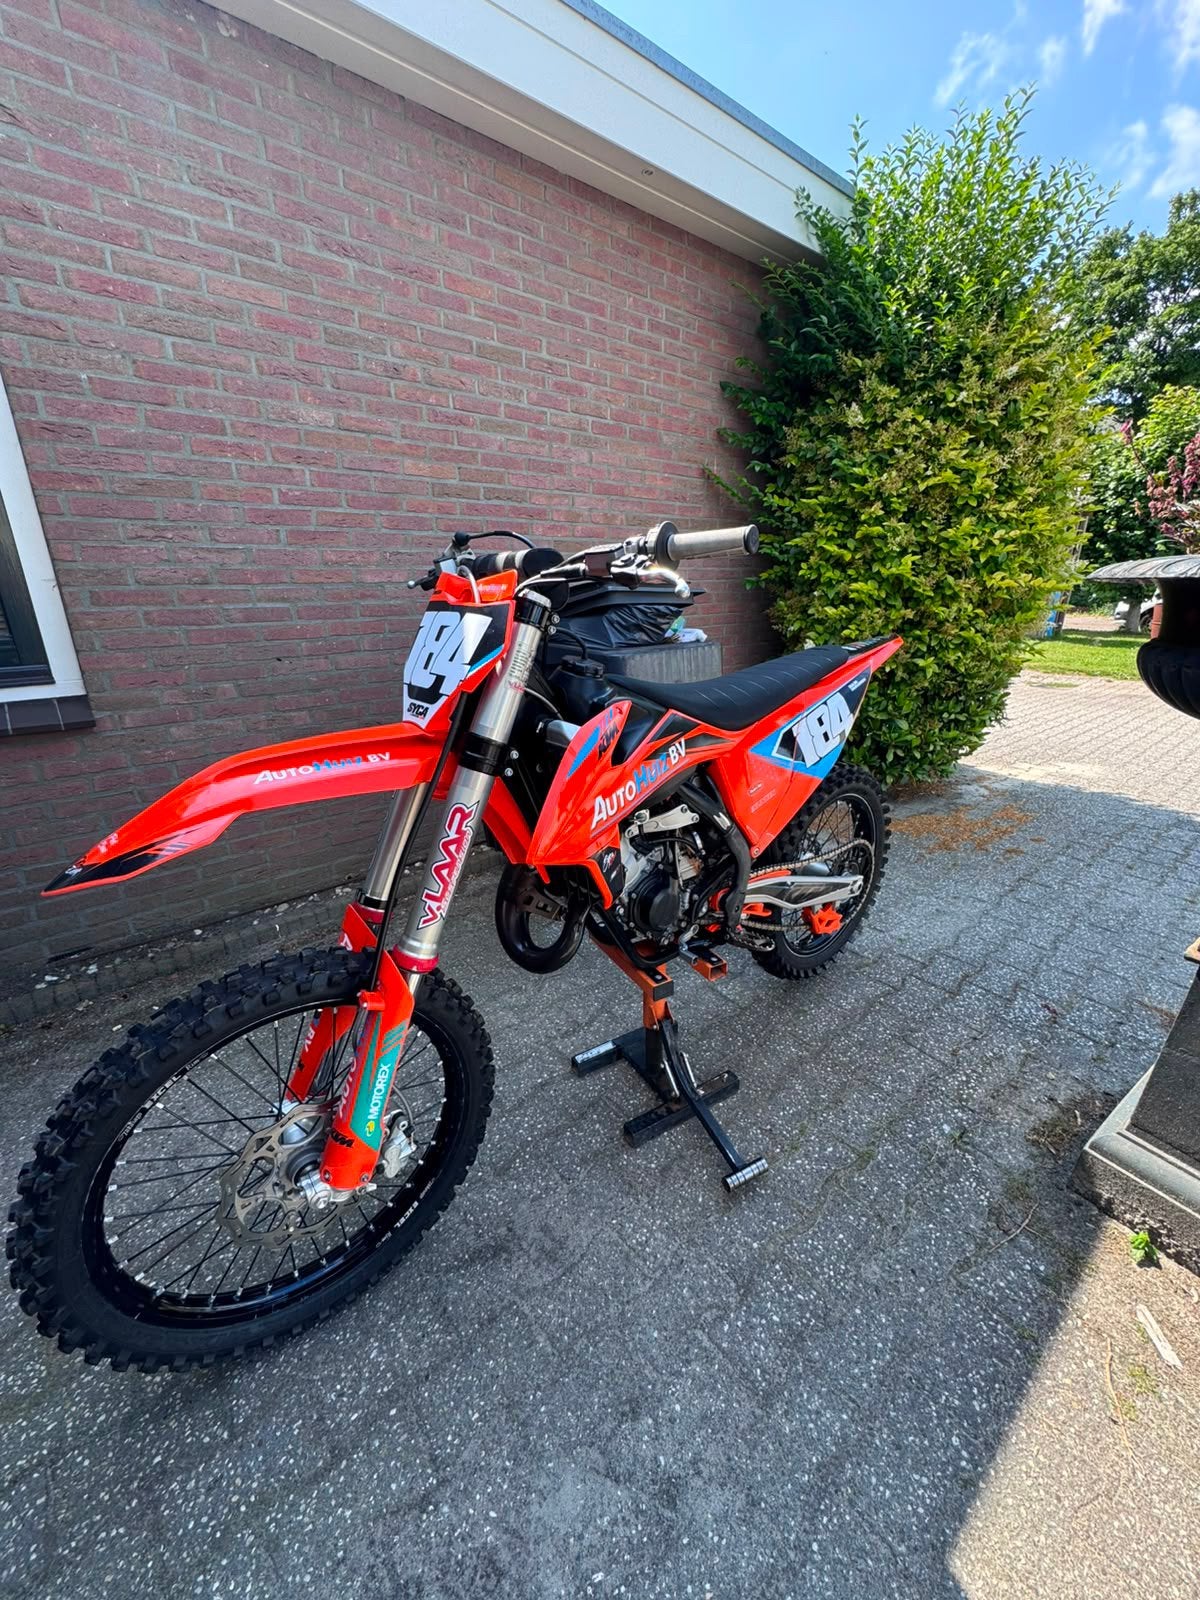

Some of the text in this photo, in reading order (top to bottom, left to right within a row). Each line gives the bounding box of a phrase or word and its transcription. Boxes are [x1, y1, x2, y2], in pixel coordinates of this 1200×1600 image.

[403, 611, 492, 697] 184
[407, 702, 430, 717] SYCA
[792, 692, 854, 768] 184
[366, 751, 391, 763] BV
[668, 738, 687, 765] BV
[144, 1072, 182, 1109] EXCEL
[368, 1063, 392, 1119] MOTOREX
[393, 1200, 420, 1228] EXCEL
